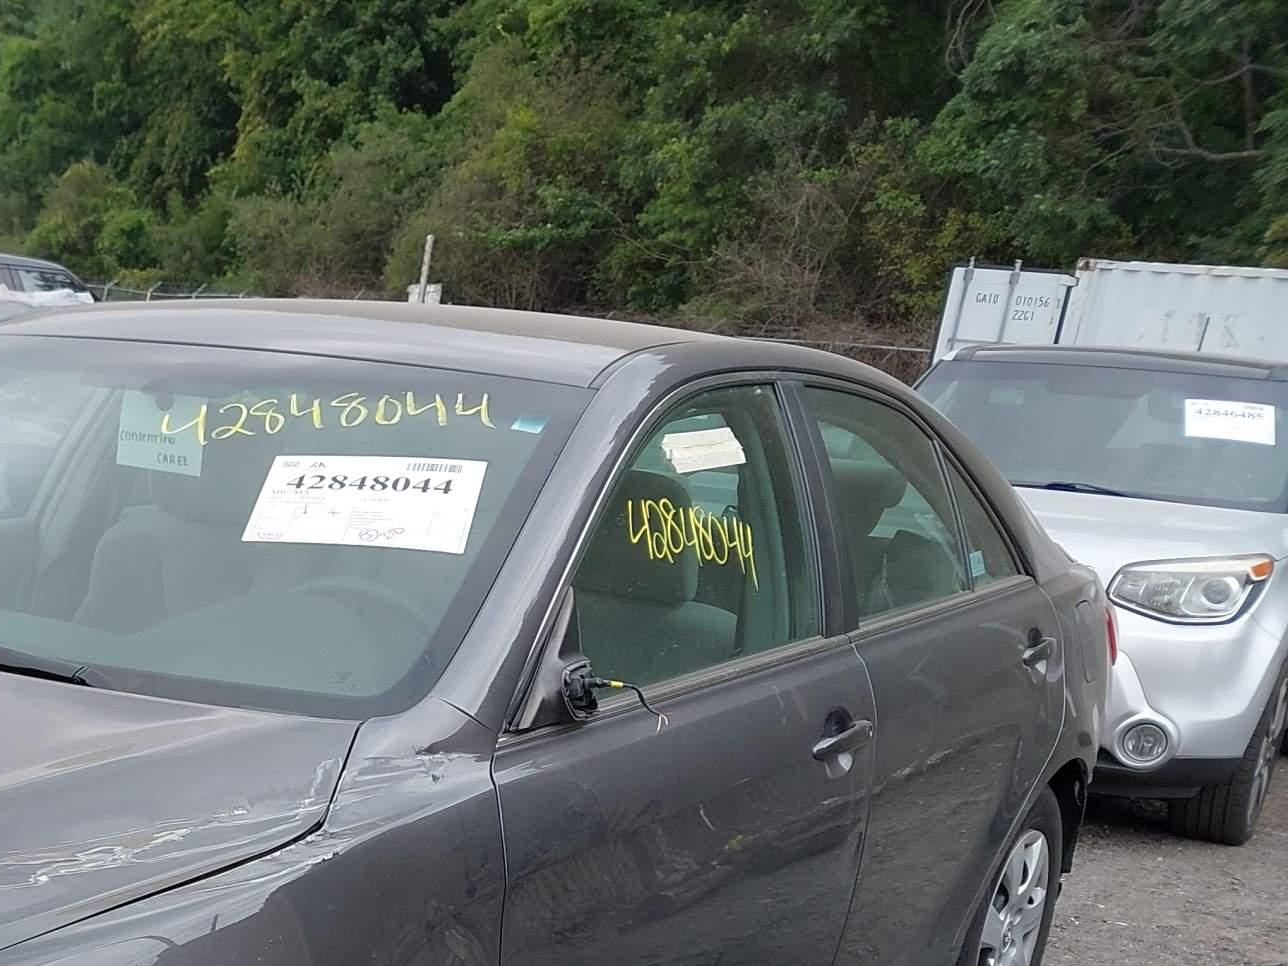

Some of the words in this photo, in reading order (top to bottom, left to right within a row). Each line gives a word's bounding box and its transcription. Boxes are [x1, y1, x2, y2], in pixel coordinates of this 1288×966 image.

[1015, 295, 1051, 308] 010156
[161, 391, 496, 446] 42848044
[286, 473, 454, 494] 42848044
[628, 498, 759, 592] 42848044
